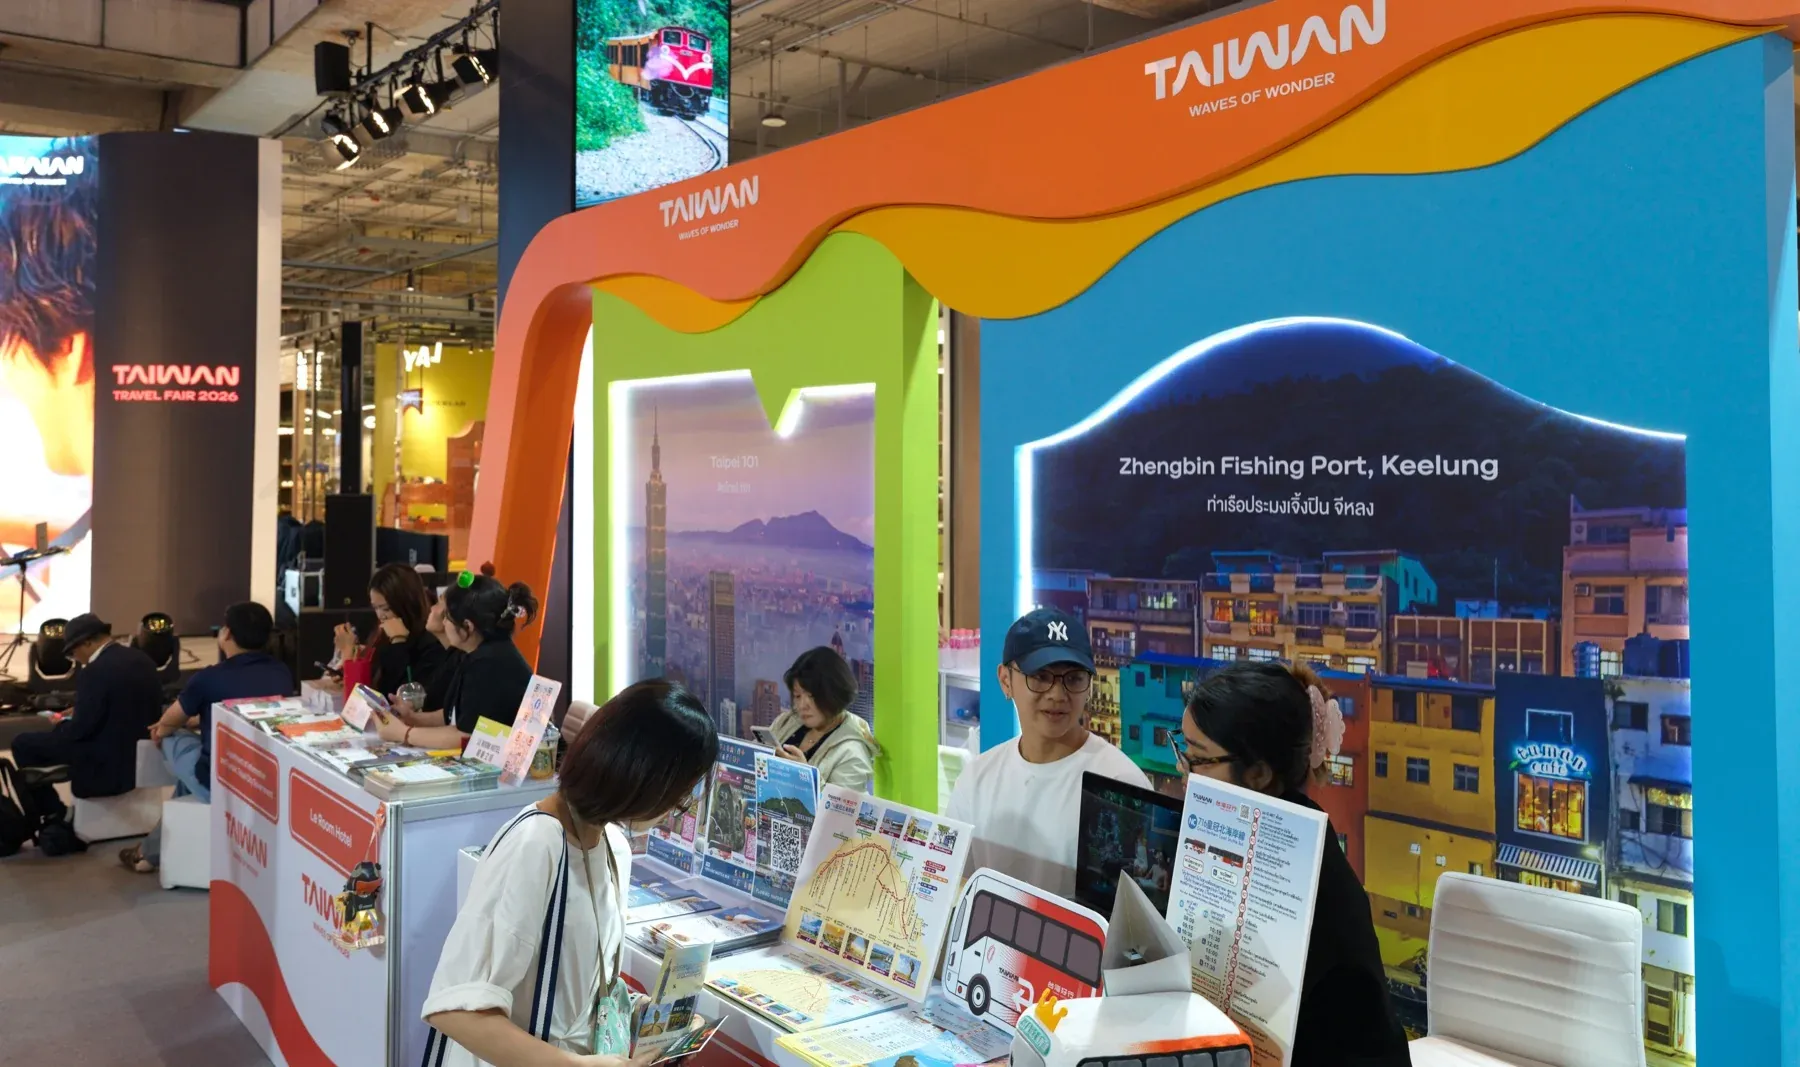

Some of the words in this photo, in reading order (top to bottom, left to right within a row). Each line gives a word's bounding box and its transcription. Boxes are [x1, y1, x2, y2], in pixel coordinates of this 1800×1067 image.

[1144, 0, 1386, 100] TAIWAN
[1189, 96, 1238, 117] WAVES
[1240, 89, 1261, 105] OF
[1264, 71, 1336, 99] WONDER
[659, 175, 759, 227] TAIWAN
[678, 228, 700, 241] WAVES
[700, 226, 710, 236] OF
[710, 219, 739, 233] WONDER
[112, 364, 240, 386] TAIWAN
[112, 390, 162, 401] TRAVEL
[163, 390, 196, 401] FAIR
[197, 391, 239, 402] 2026
[710, 455, 739, 470] Taipei
[741, 455, 759, 468] 101
[1119, 456, 1215, 480] Zhengbin
[1220, 455, 1305, 480] Fishing
[1311, 455, 1374, 480] Port,
[1382, 454, 1499, 481] Keelung
[1334, 495, 1374, 517] จีหลง
[1516, 744, 1587, 771] tuman
[1192, 792, 1213, 804] TAIWAN
[225, 811, 267, 868] TAIWAN
[317, 813, 335, 836] Room
[335, 825, 353, 848] Hotel
[998, 966, 1020, 982] TAIWAN
